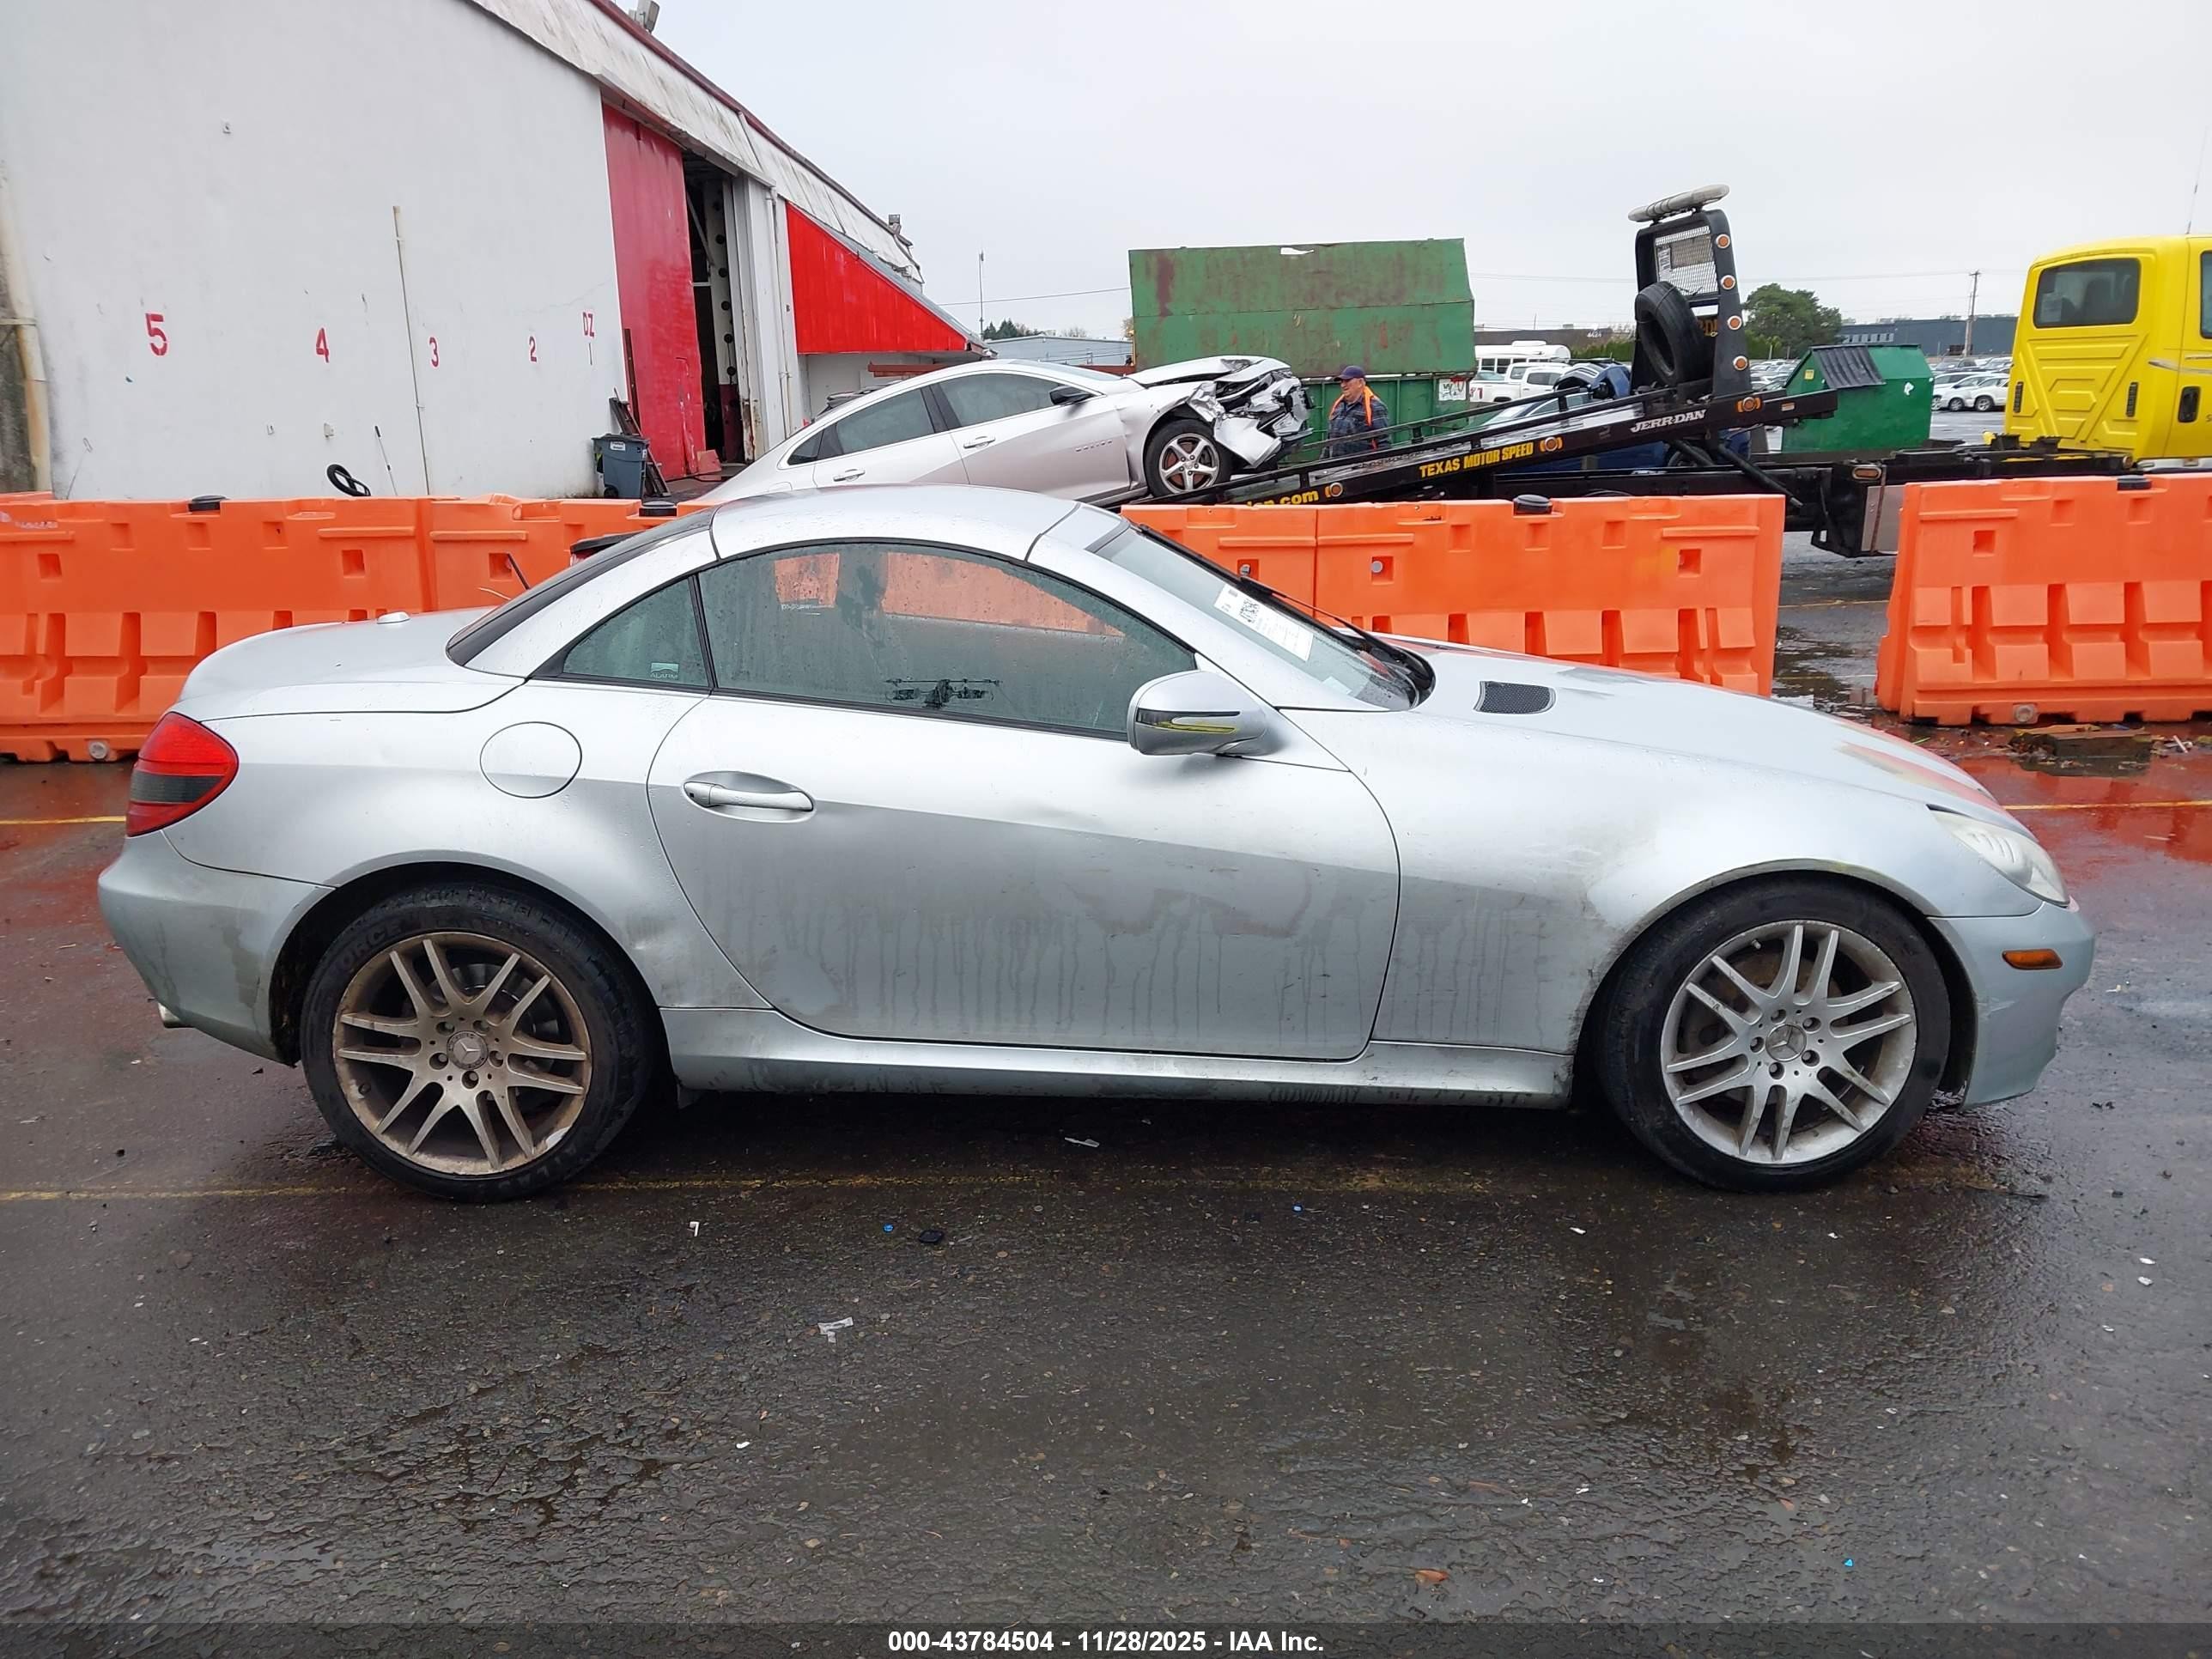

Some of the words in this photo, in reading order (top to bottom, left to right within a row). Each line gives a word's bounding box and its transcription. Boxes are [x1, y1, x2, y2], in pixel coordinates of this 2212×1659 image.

[145, 313, 168, 356] 5
[315, 327, 330, 364] 4
[429, 336, 440, 368] 3
[528, 336, 538, 362] 2
[1419, 458, 1460, 478] TEXAS
[1463, 449, 1500, 470] MOTOR
[1502, 441, 1534, 461] SPEED
